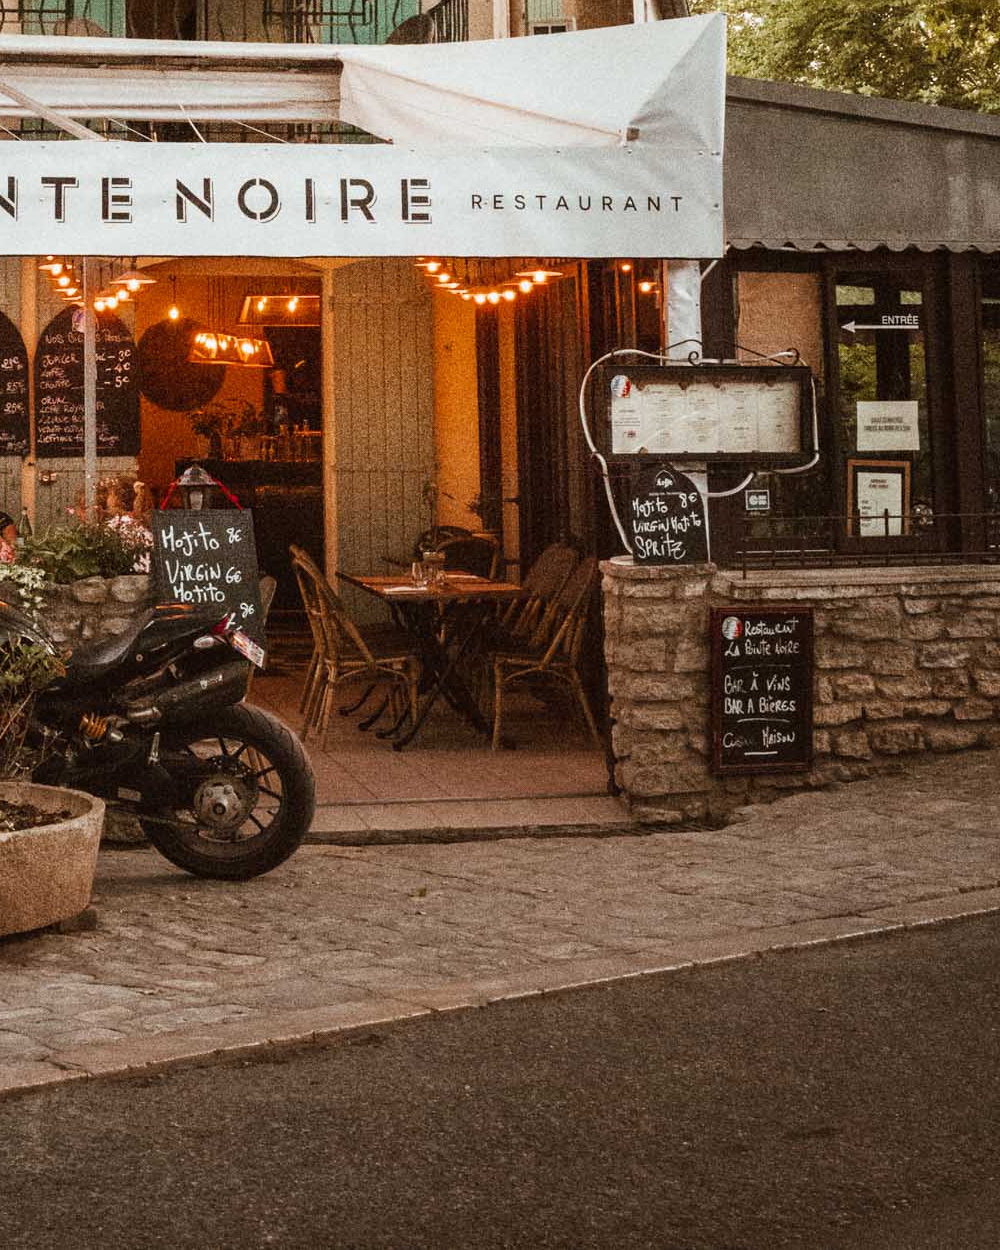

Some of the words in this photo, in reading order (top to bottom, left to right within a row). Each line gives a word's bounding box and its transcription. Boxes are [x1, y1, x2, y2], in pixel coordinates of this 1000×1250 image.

[177, 178, 432, 222] NOIRE
[472, 195, 684, 212] RESTAURANT
[881, 314, 919, 325] ENTRÉE
[679, 492, 698, 508] 8€
[161, 522, 220, 556] Mojito
[226, 527, 242, 543] 8€
[225, 566, 242, 584] 6€
[724, 698, 744, 715] BAR
